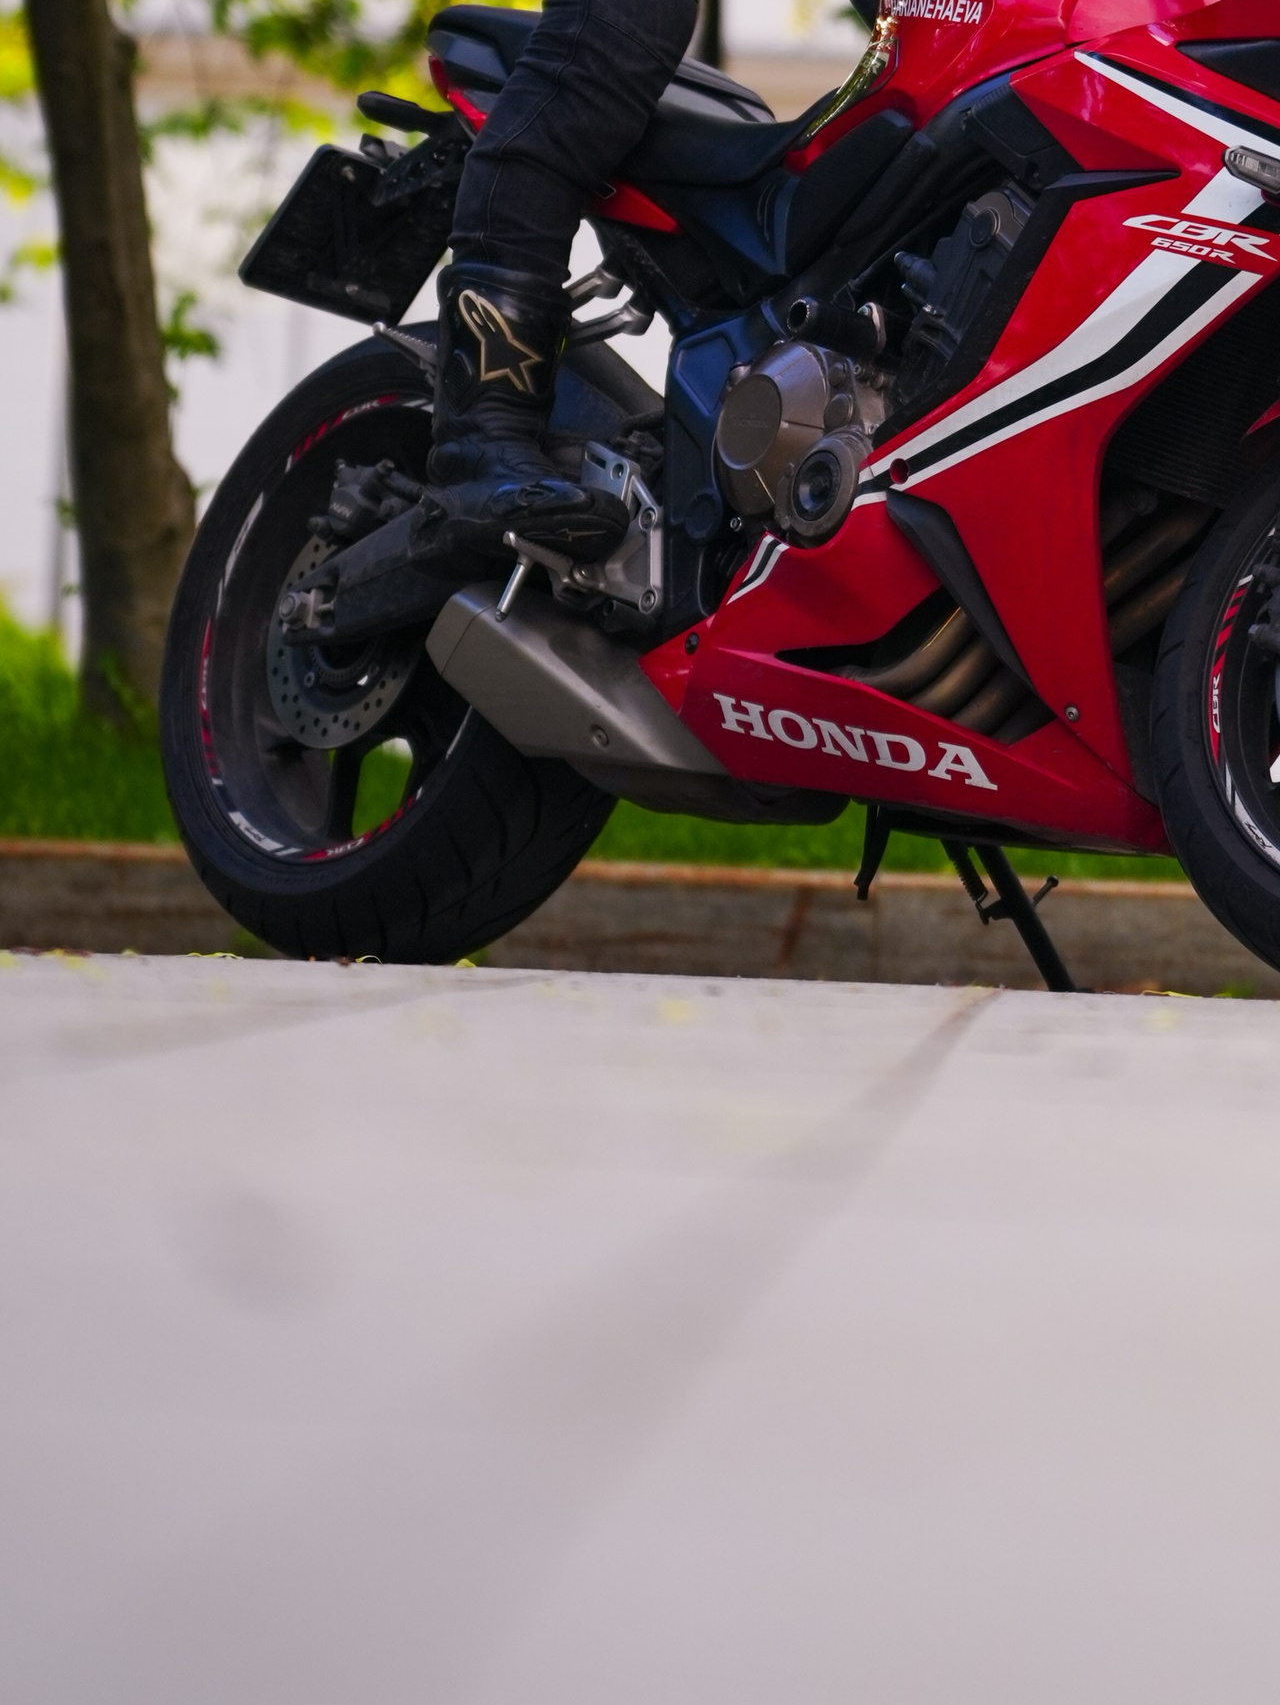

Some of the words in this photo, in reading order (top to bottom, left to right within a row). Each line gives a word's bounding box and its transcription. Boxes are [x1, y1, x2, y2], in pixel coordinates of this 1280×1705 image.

[1122, 214, 1278, 261] CBR
[1151, 236, 1236, 264] 650R
[1212, 673, 1221, 734] CBR
[713, 692, 998, 791] HONDA
